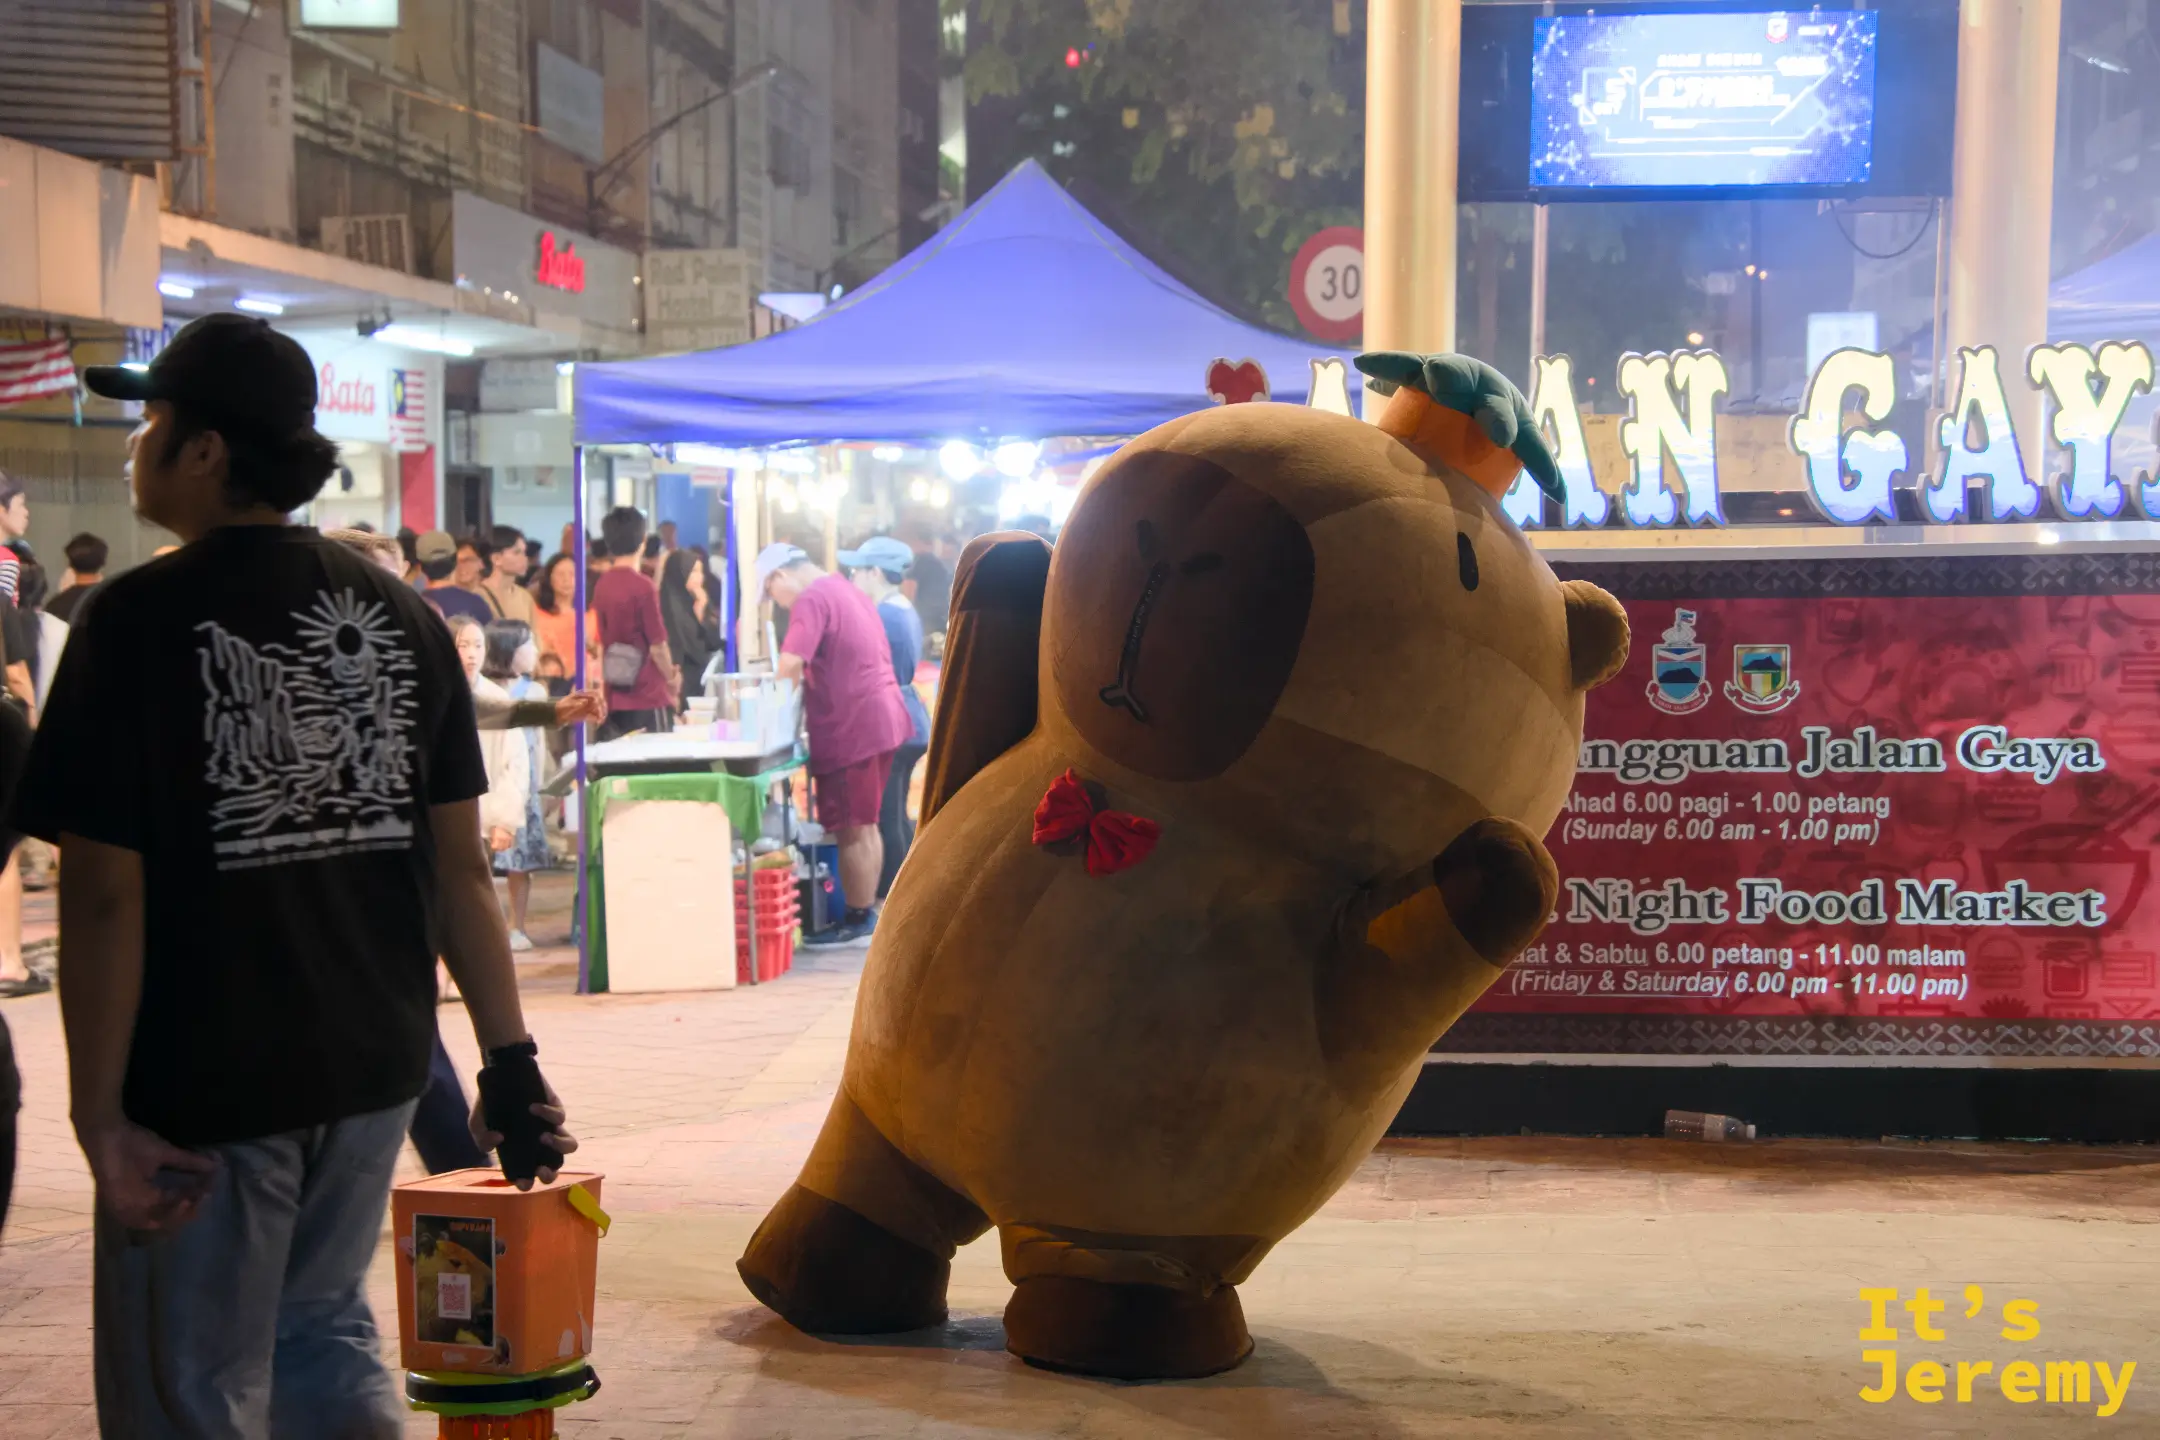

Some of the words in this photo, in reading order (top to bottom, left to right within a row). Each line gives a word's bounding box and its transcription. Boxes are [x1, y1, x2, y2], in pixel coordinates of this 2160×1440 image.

[1321, 264, 1361, 300] 30
[317, 361, 376, 416] Bata
[1800, 729, 1943, 775] Jalan
[1959, 728, 2102, 782] Gaya
[1623, 791, 1671, 813] 6.00
[1680, 792, 1728, 818] pagi
[1751, 792, 1800, 813] 1.00
[1808, 793, 1890, 818] petang
[1563, 818, 1656, 844] (Sunday
[1664, 819, 1714, 840] 6.00
[1720, 824, 1755, 840] am
[1778, 819, 1828, 840] 1.00
[1834, 819, 1879, 845] pm)
[1567, 880, 1727, 933] Night
[1739, 880, 1885, 923] Food
[1898, 881, 2104, 924] Market
[1555, 943, 1572, 963] &
[1579, 943, 1647, 964] Sabtu
[1655, 943, 1704, 964] 6.00
[1712, 944, 1792, 968] petang
[1816, 944, 1879, 965] 11.00
[1887, 945, 1966, 966] malam
[1512, 970, 1592, 996] (Friday
[1598, 971, 1615, 991] &
[1622, 971, 1728, 996] Saturday
[1734, 972, 1785, 993] 6.00
[1791, 977, 1827, 998] pm
[1850, 973, 1915, 995] 11.00
[1920, 974, 1968, 1000] pm)
